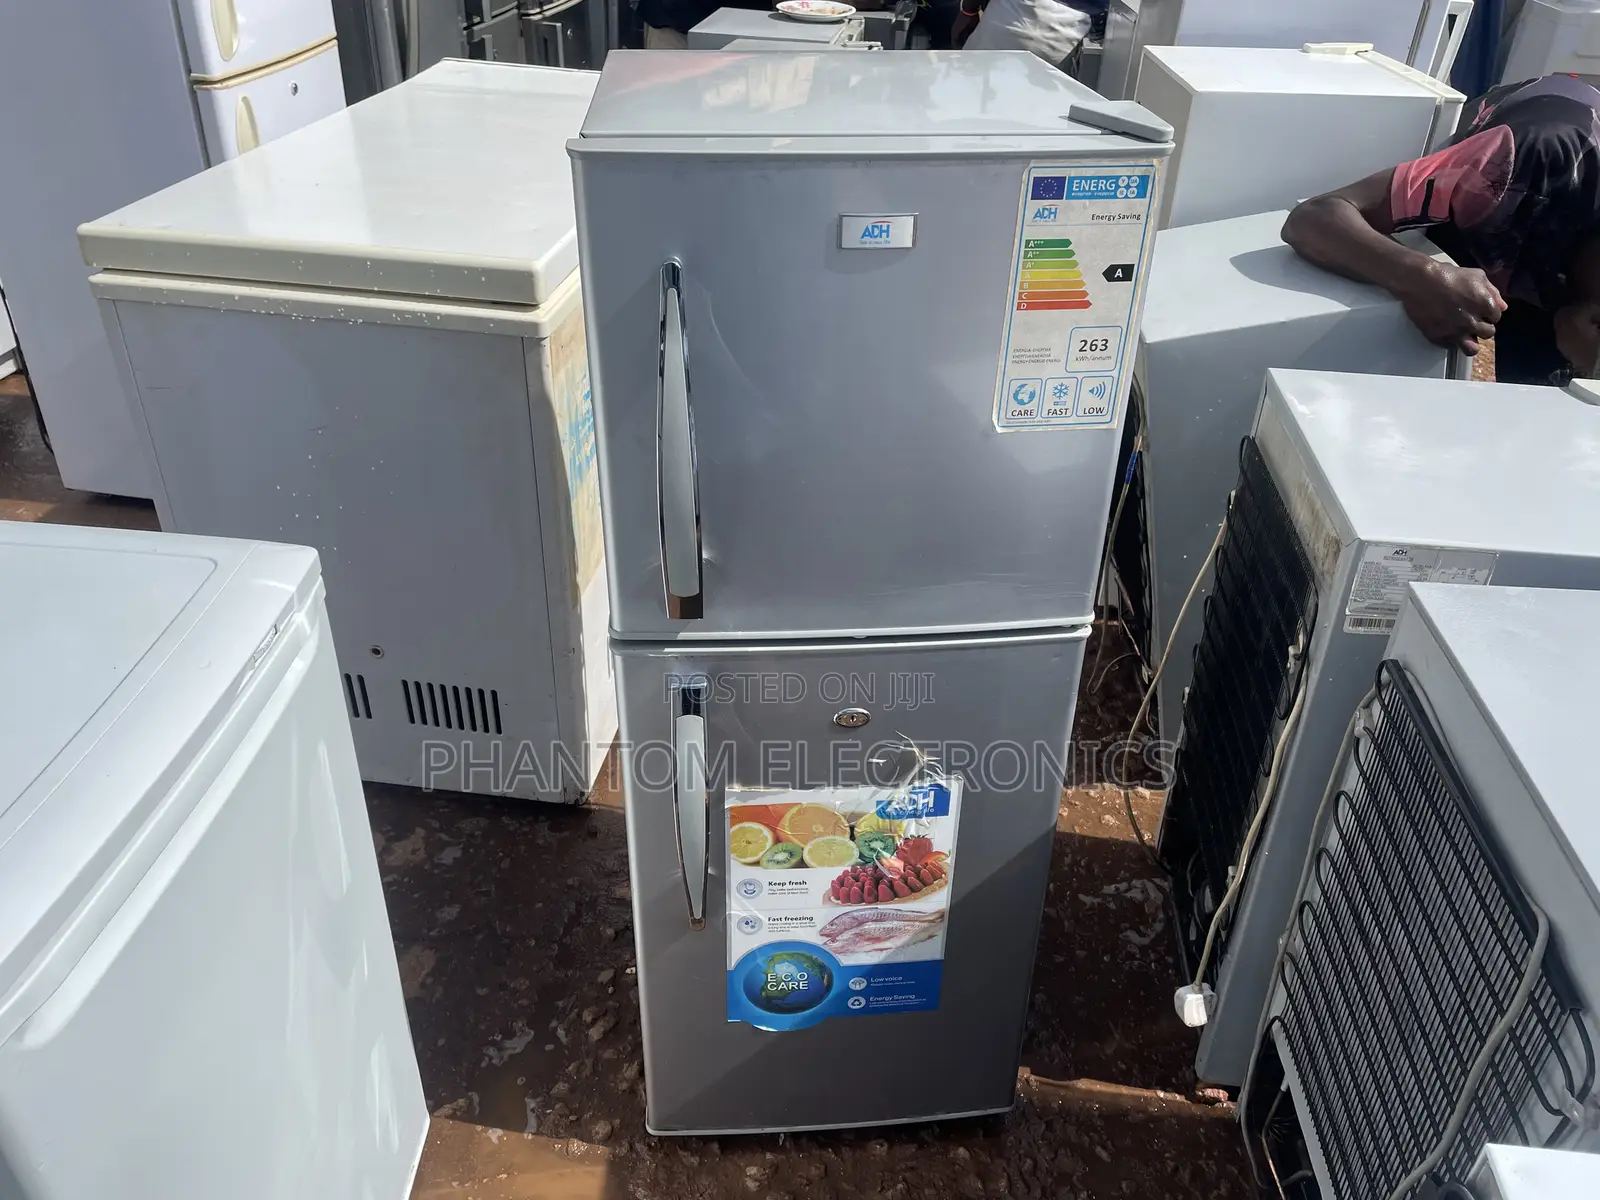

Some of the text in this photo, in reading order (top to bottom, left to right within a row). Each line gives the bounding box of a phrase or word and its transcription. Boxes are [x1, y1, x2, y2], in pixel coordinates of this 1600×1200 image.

[1072, 179, 1116, 191] ENERG
[1032, 207, 1058, 220] ADH
[1091, 212, 1141, 221] Energy Saving
[860, 224, 891, 239] ADH
[1113, 268, 1123, 278] A
[1078, 338, 1109, 353] 263
[1011, 406, 1105, 417] CARE FAST LOW
[784, 915, 814, 923] freezing
[767, 981, 808, 991] CARE
